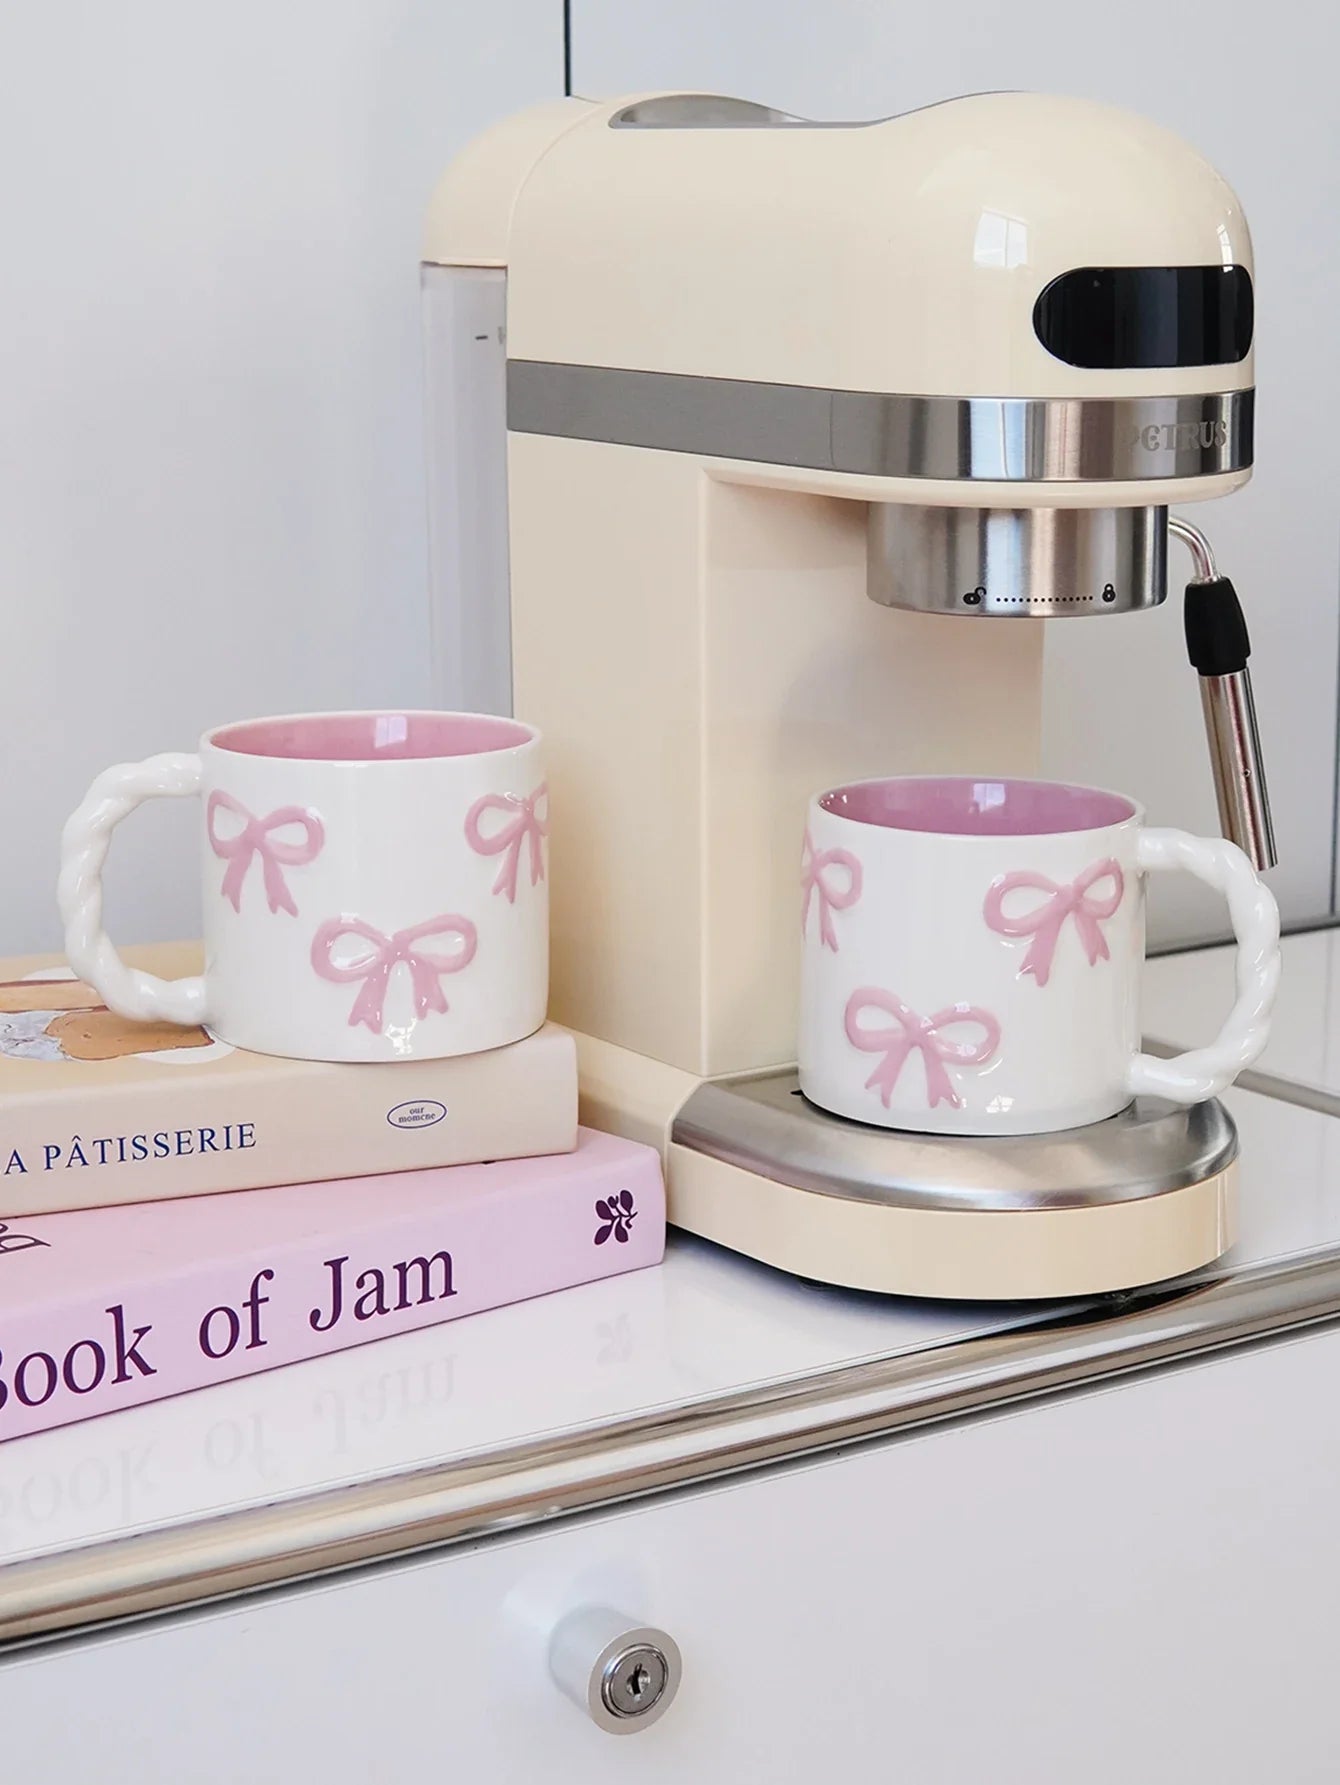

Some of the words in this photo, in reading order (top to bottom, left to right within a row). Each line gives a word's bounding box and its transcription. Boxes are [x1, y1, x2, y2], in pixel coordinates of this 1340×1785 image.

[43, 1123, 257, 1171] PÂTISSERIE
[0, 1305, 158, 1410] ook
[199, 1268, 275, 1358] of
[309, 1250, 458, 1331] Jam
